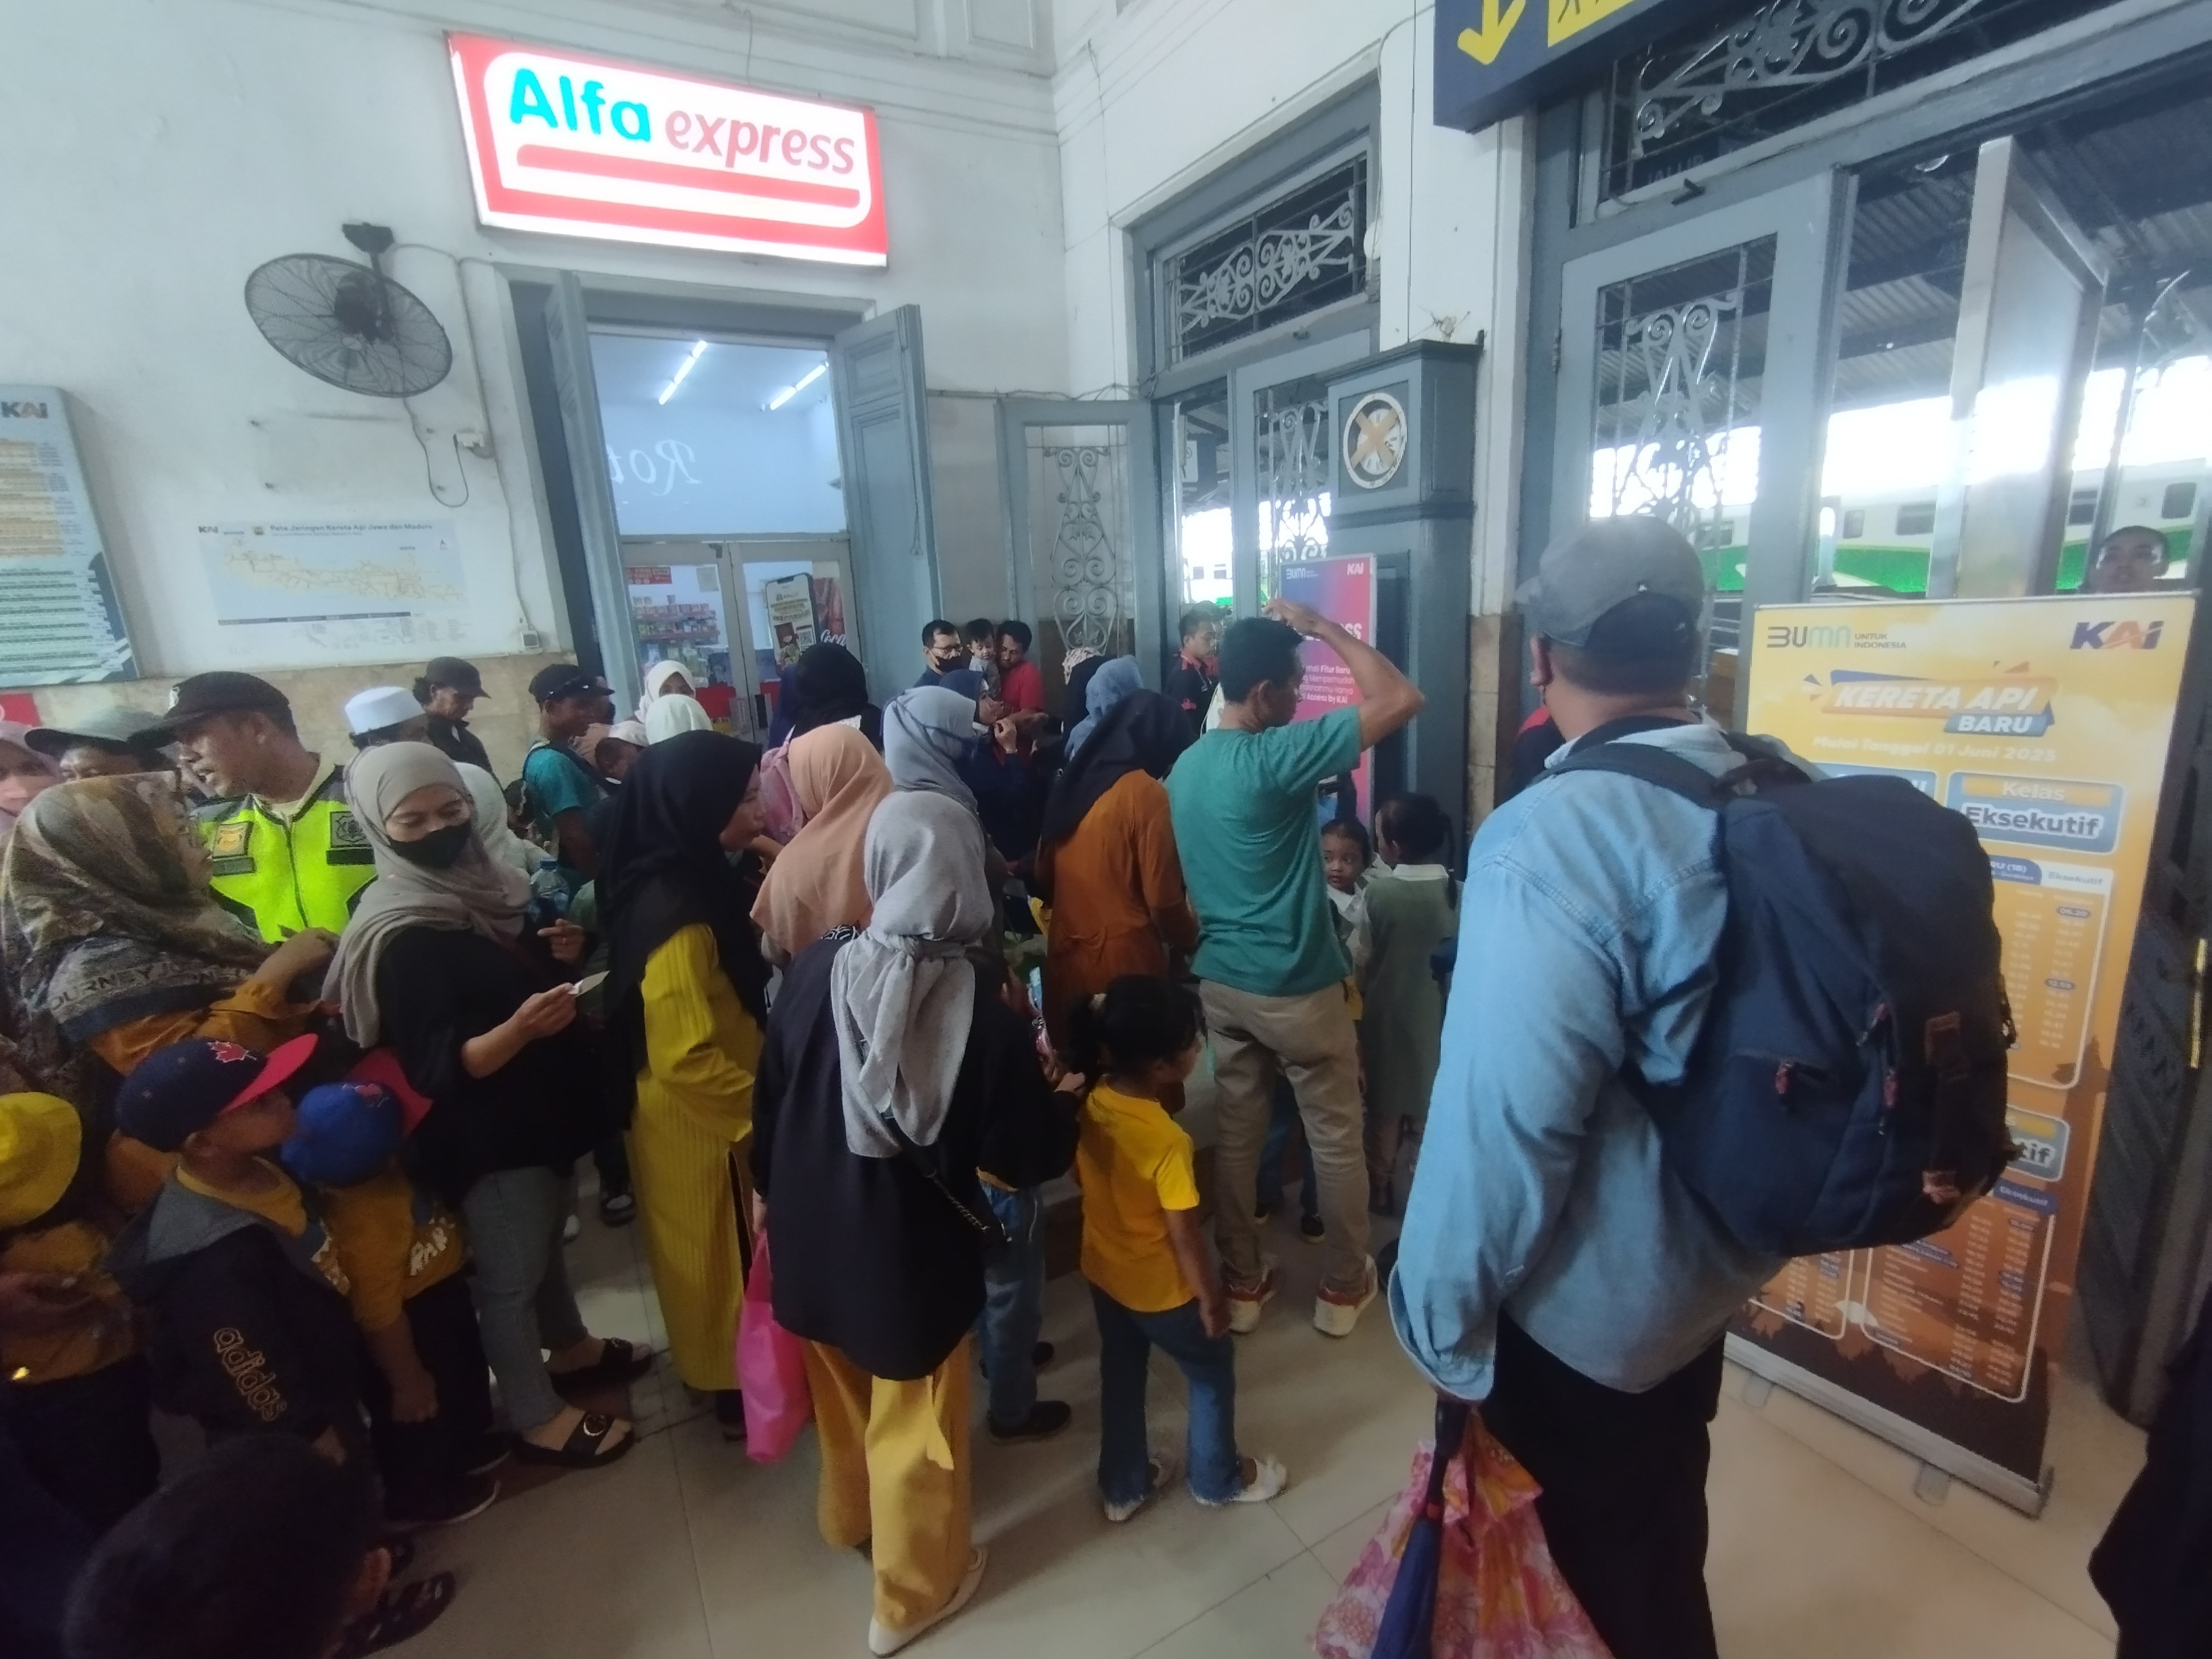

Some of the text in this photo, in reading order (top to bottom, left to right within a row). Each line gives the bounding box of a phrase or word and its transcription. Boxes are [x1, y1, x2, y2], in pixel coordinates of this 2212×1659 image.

[510, 68, 855, 175] Alfa express
[1, 401, 48, 419] KAI
[199, 526, 219, 534] KAI
[1347, 562, 1364, 575] KAI
[2069, 621, 2165, 649] KAI
[1834, 686, 2039, 711] KERETA API
[1957, 715, 2033, 733] BARU
[1813, 736, 1858, 750] Mulai
[1863, 739, 1931, 756] Tanggal
[1958, 745, 1997, 760] Juni
[2002, 781, 2066, 802] Kelas
[1966, 806, 2101, 836] Eksekutif
[2048, 871, 2103, 885] Eksekutif
[213, 1327, 287, 1421] adidas
